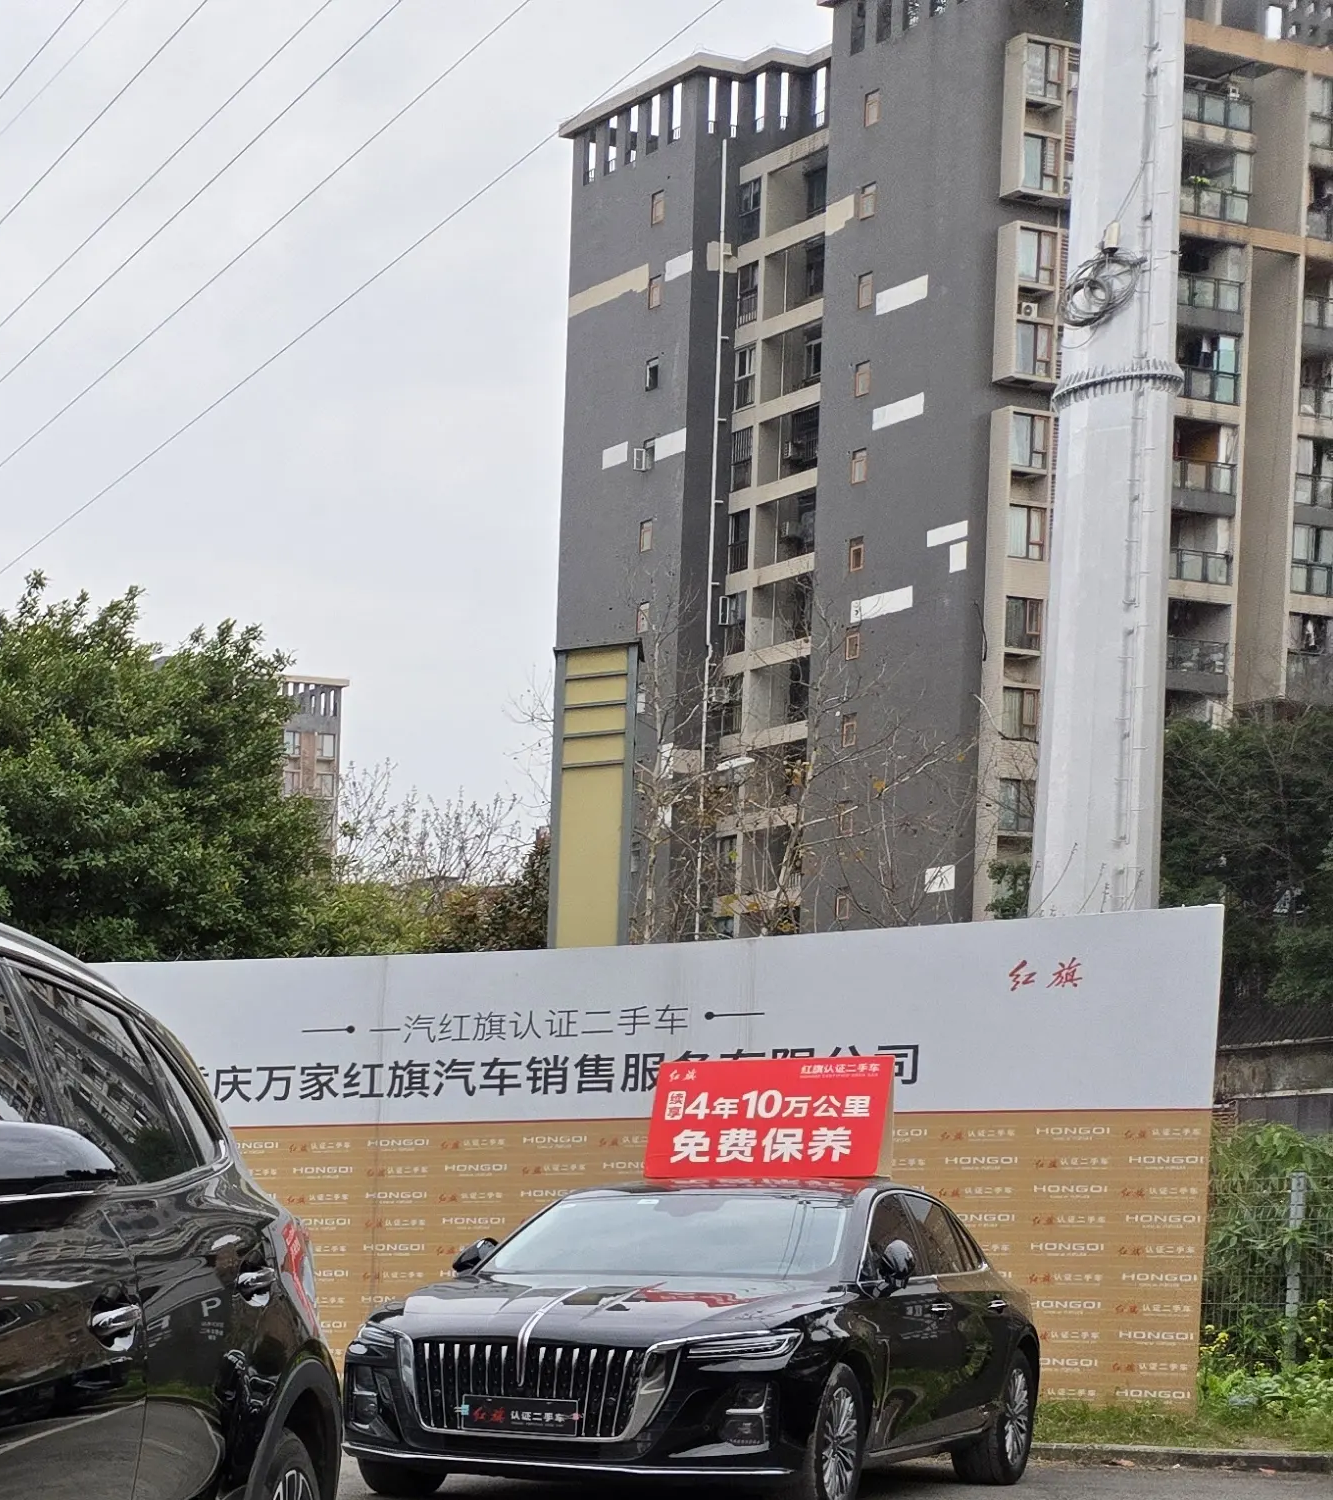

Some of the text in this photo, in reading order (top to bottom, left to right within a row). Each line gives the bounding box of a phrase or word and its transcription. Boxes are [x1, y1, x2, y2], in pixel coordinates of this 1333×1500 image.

[1009, 957, 1083, 991] 红旗
[369, 1003, 689, 1044] 一汽红旗认证二手车
[201, 1044, 919, 1104] 庆万家红旗汽车销售服司
[685, 1089, 870, 1120] 4年10万公里
[670, 1126, 852, 1163] 免费保养
